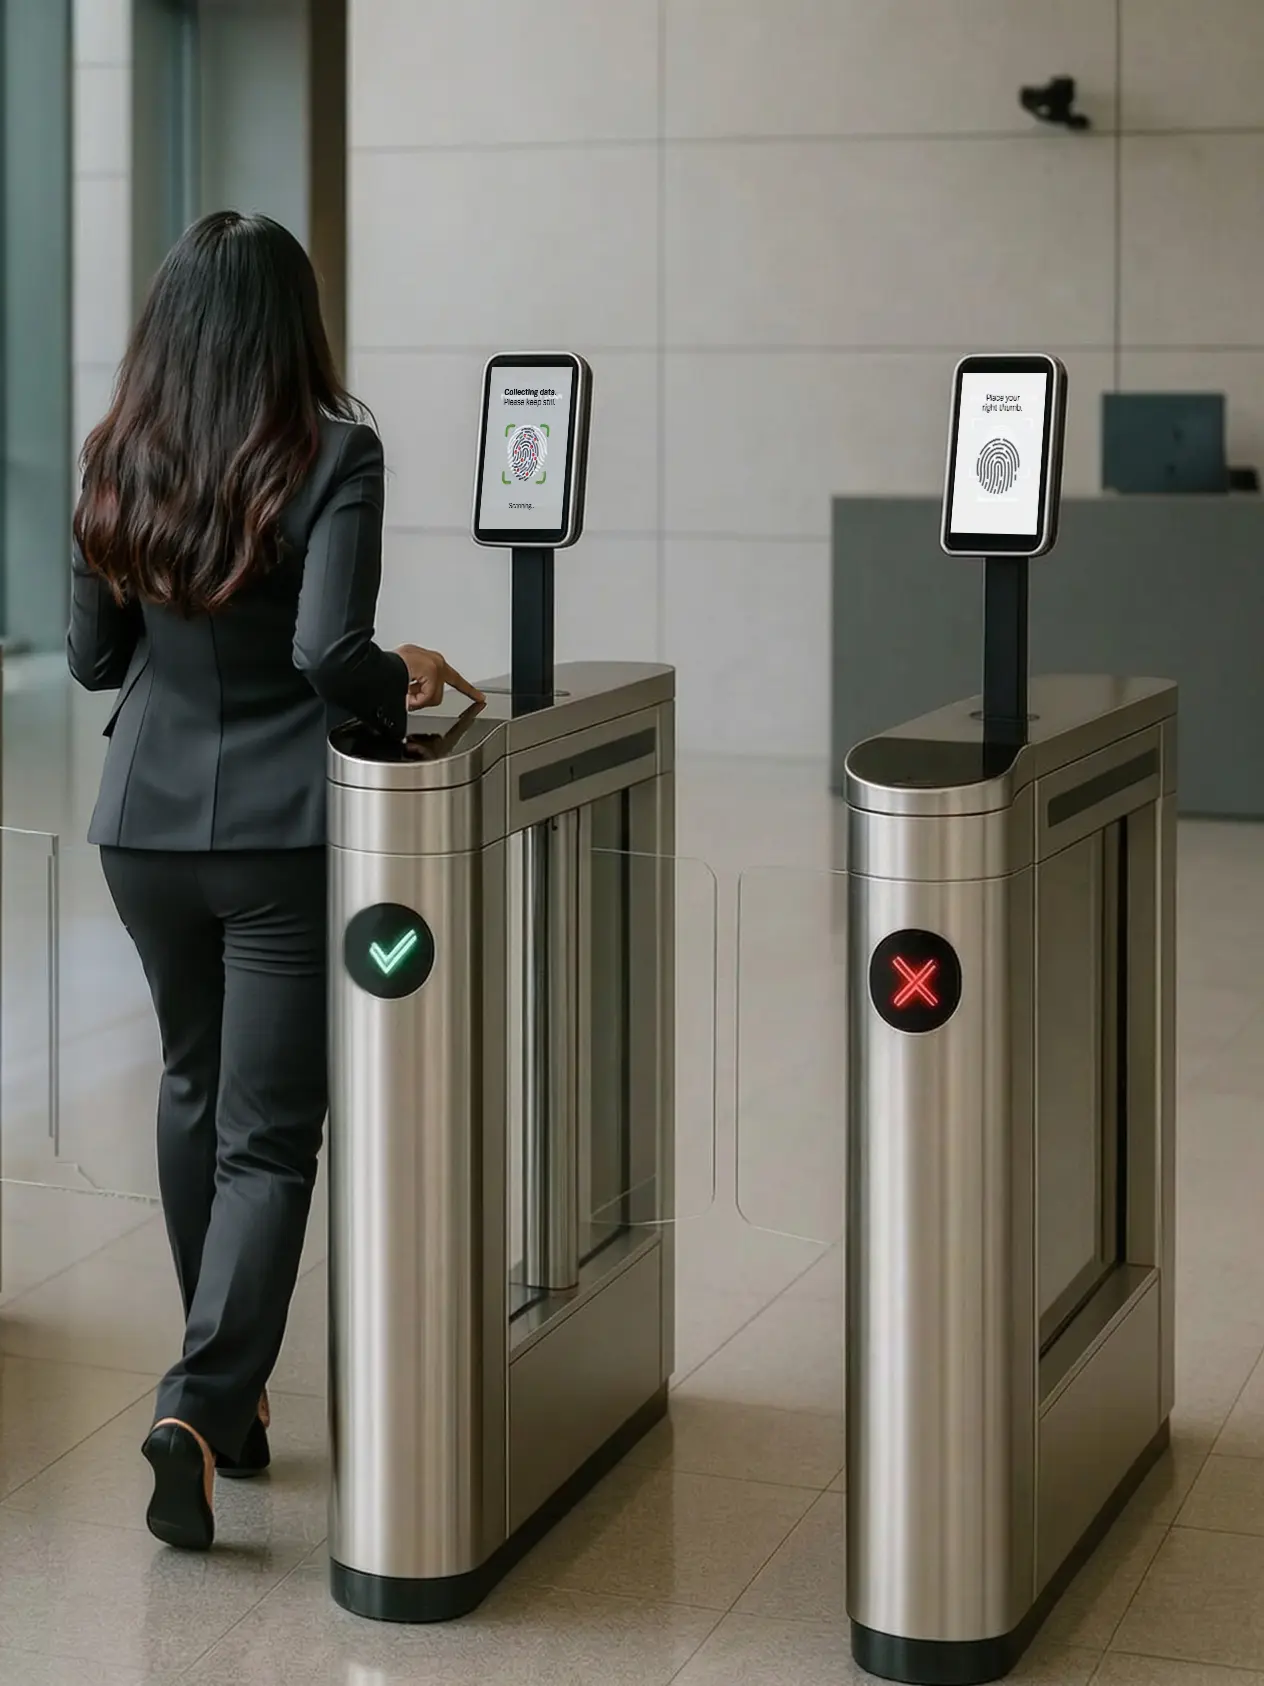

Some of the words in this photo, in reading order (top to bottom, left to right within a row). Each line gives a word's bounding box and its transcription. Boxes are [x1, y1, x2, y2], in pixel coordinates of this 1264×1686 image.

[504, 388, 539, 398] Collecting
[539, 388, 557, 396] data.
[503, 398, 525, 406] Please
[525, 398, 542, 408] keep
[986, 394, 1005, 402] Place
[1005, 395, 1021, 404] your
